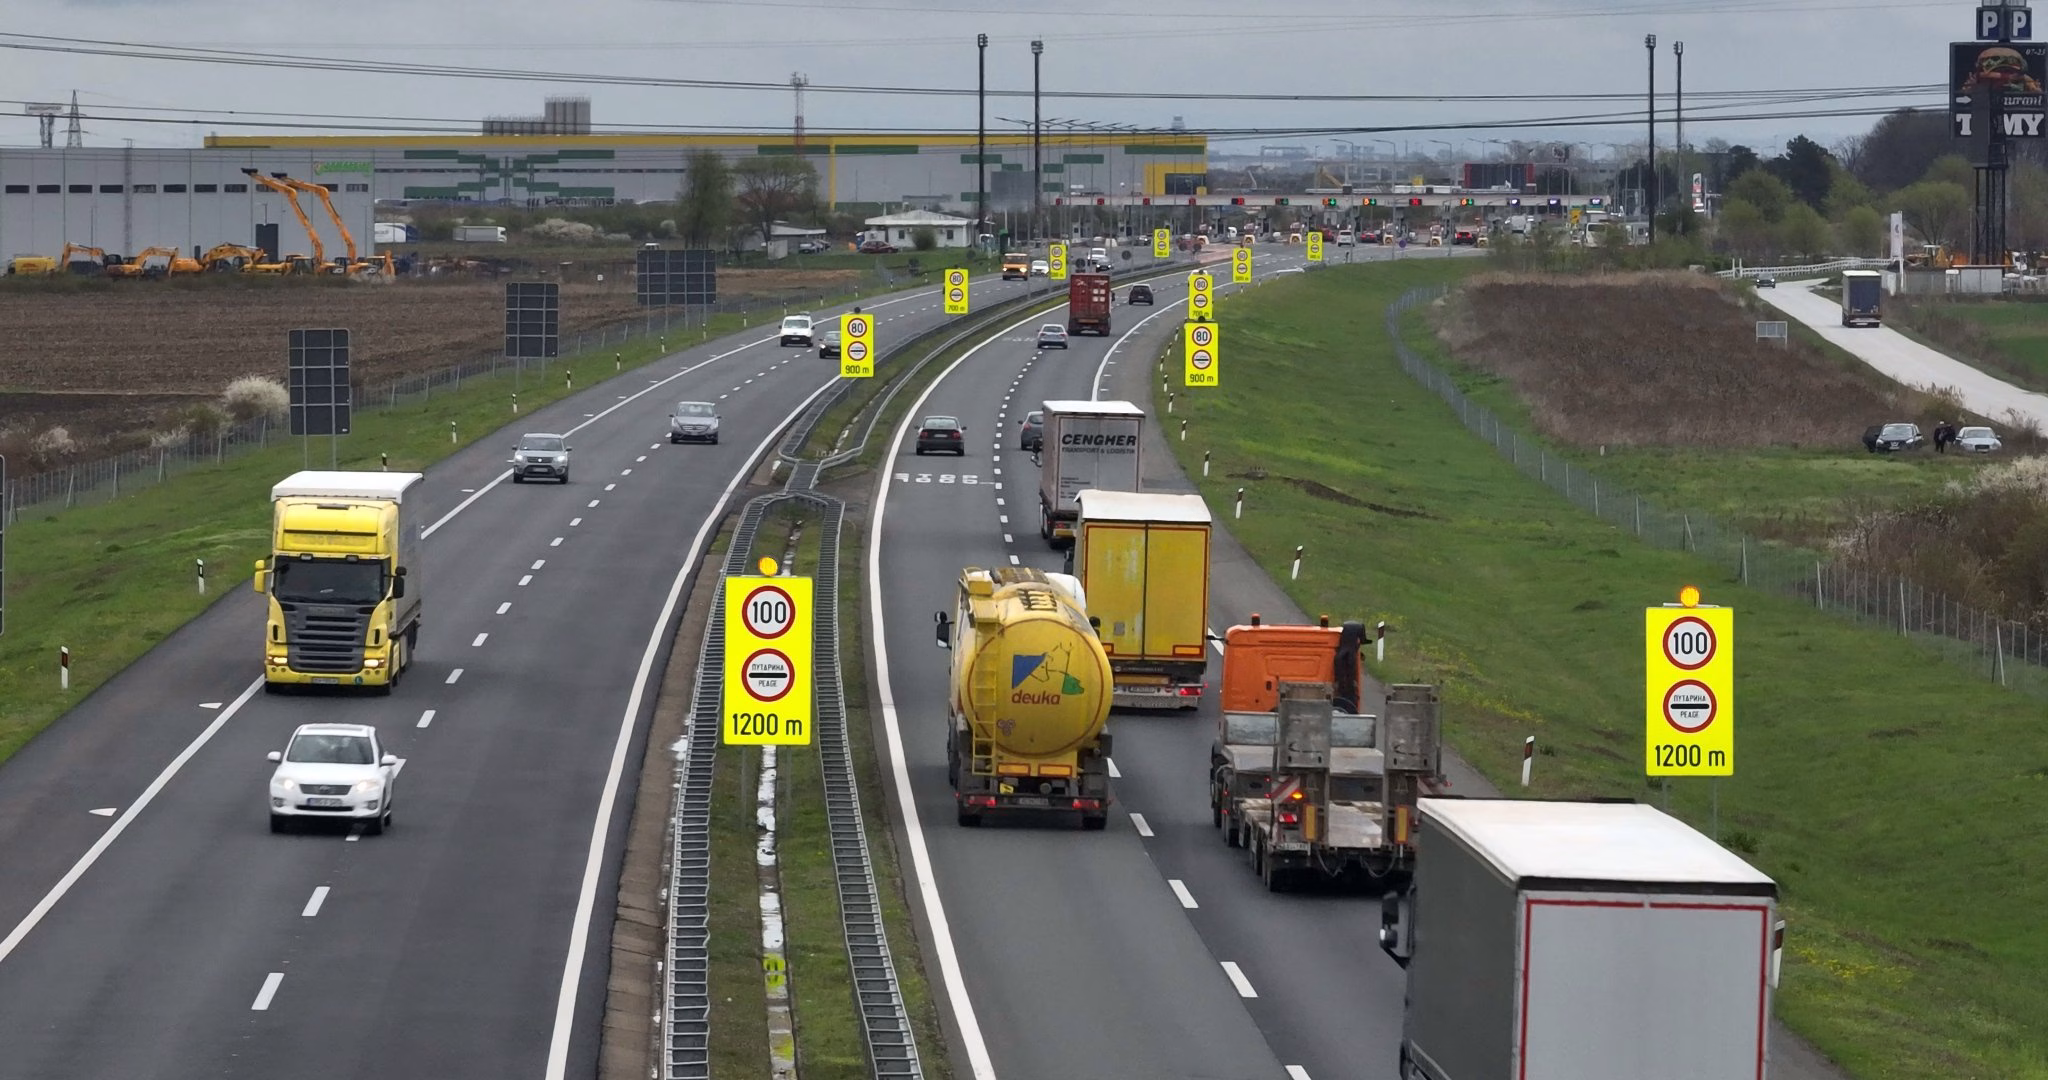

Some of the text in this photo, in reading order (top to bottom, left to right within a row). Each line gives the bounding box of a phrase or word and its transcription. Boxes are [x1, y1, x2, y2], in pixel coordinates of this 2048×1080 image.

[1982, 11, 1998, 36] P
[2012, 11, 2026, 36] P
[1956, 114, 2044, 136] TMY
[851, 323, 863, 333] 80
[1196, 331, 1208, 341] 80
[846, 365, 860, 374] 900
[1190, 374, 1204, 382] 900
[1062, 434, 1136, 446] CENGHER
[752, 601, 787, 623] 100
[1673, 632, 1708, 655] 100
[752, 663, 784, 671] ПУТАРИНА
[1011, 690, 1061, 704] deuka
[733, 713, 802, 735] 1200 m
[1655, 744, 1725, 767] 1200 m
